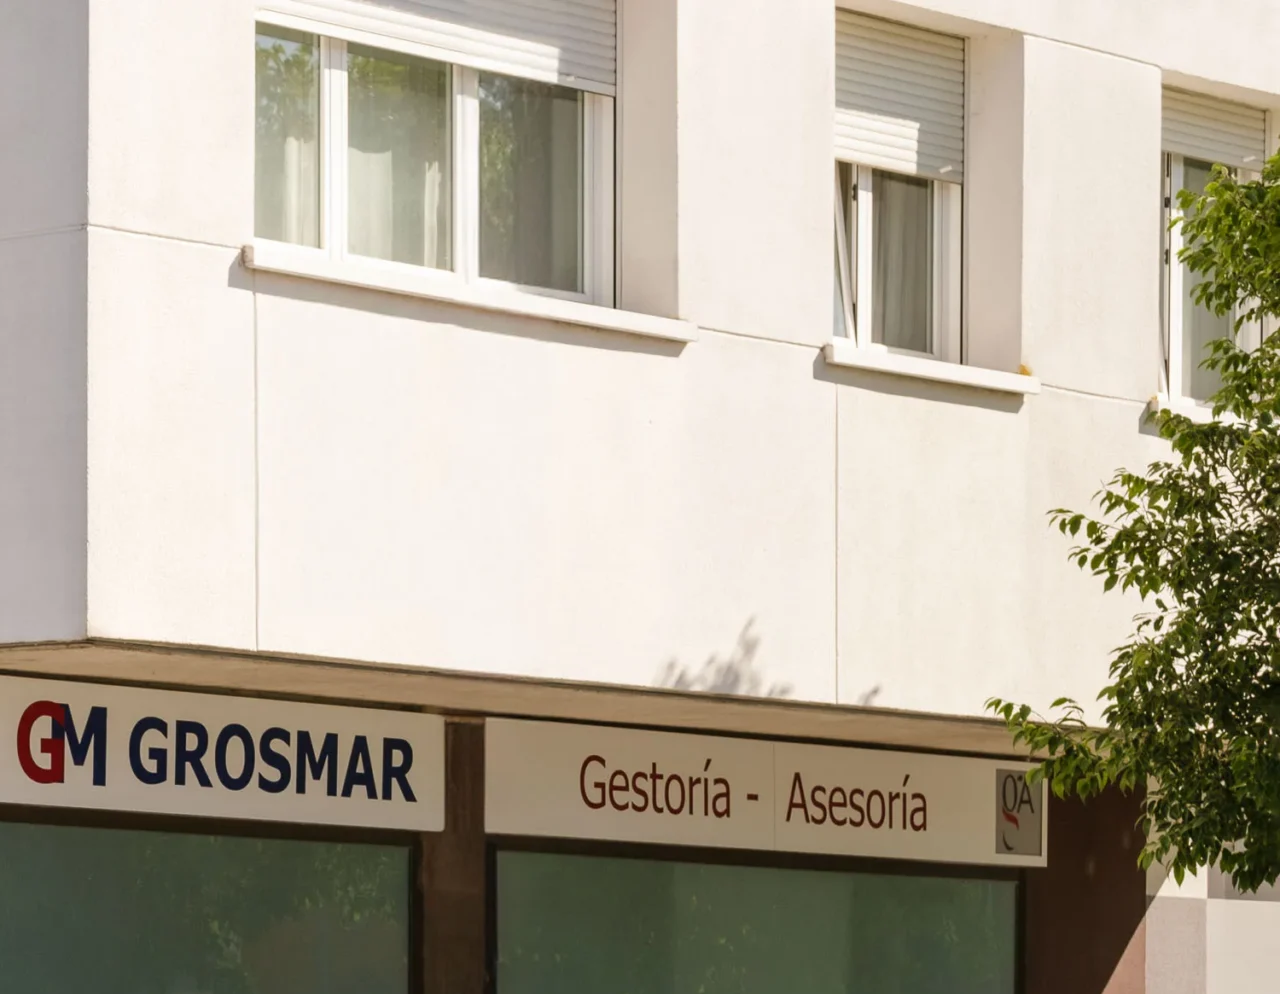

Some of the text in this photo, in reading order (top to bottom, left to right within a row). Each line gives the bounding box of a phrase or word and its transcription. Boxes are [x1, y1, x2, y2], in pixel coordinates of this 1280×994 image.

[17, 700, 417, 802] GM GROSMAR
[579, 754, 928, 832] Gestoría - Asesoría
